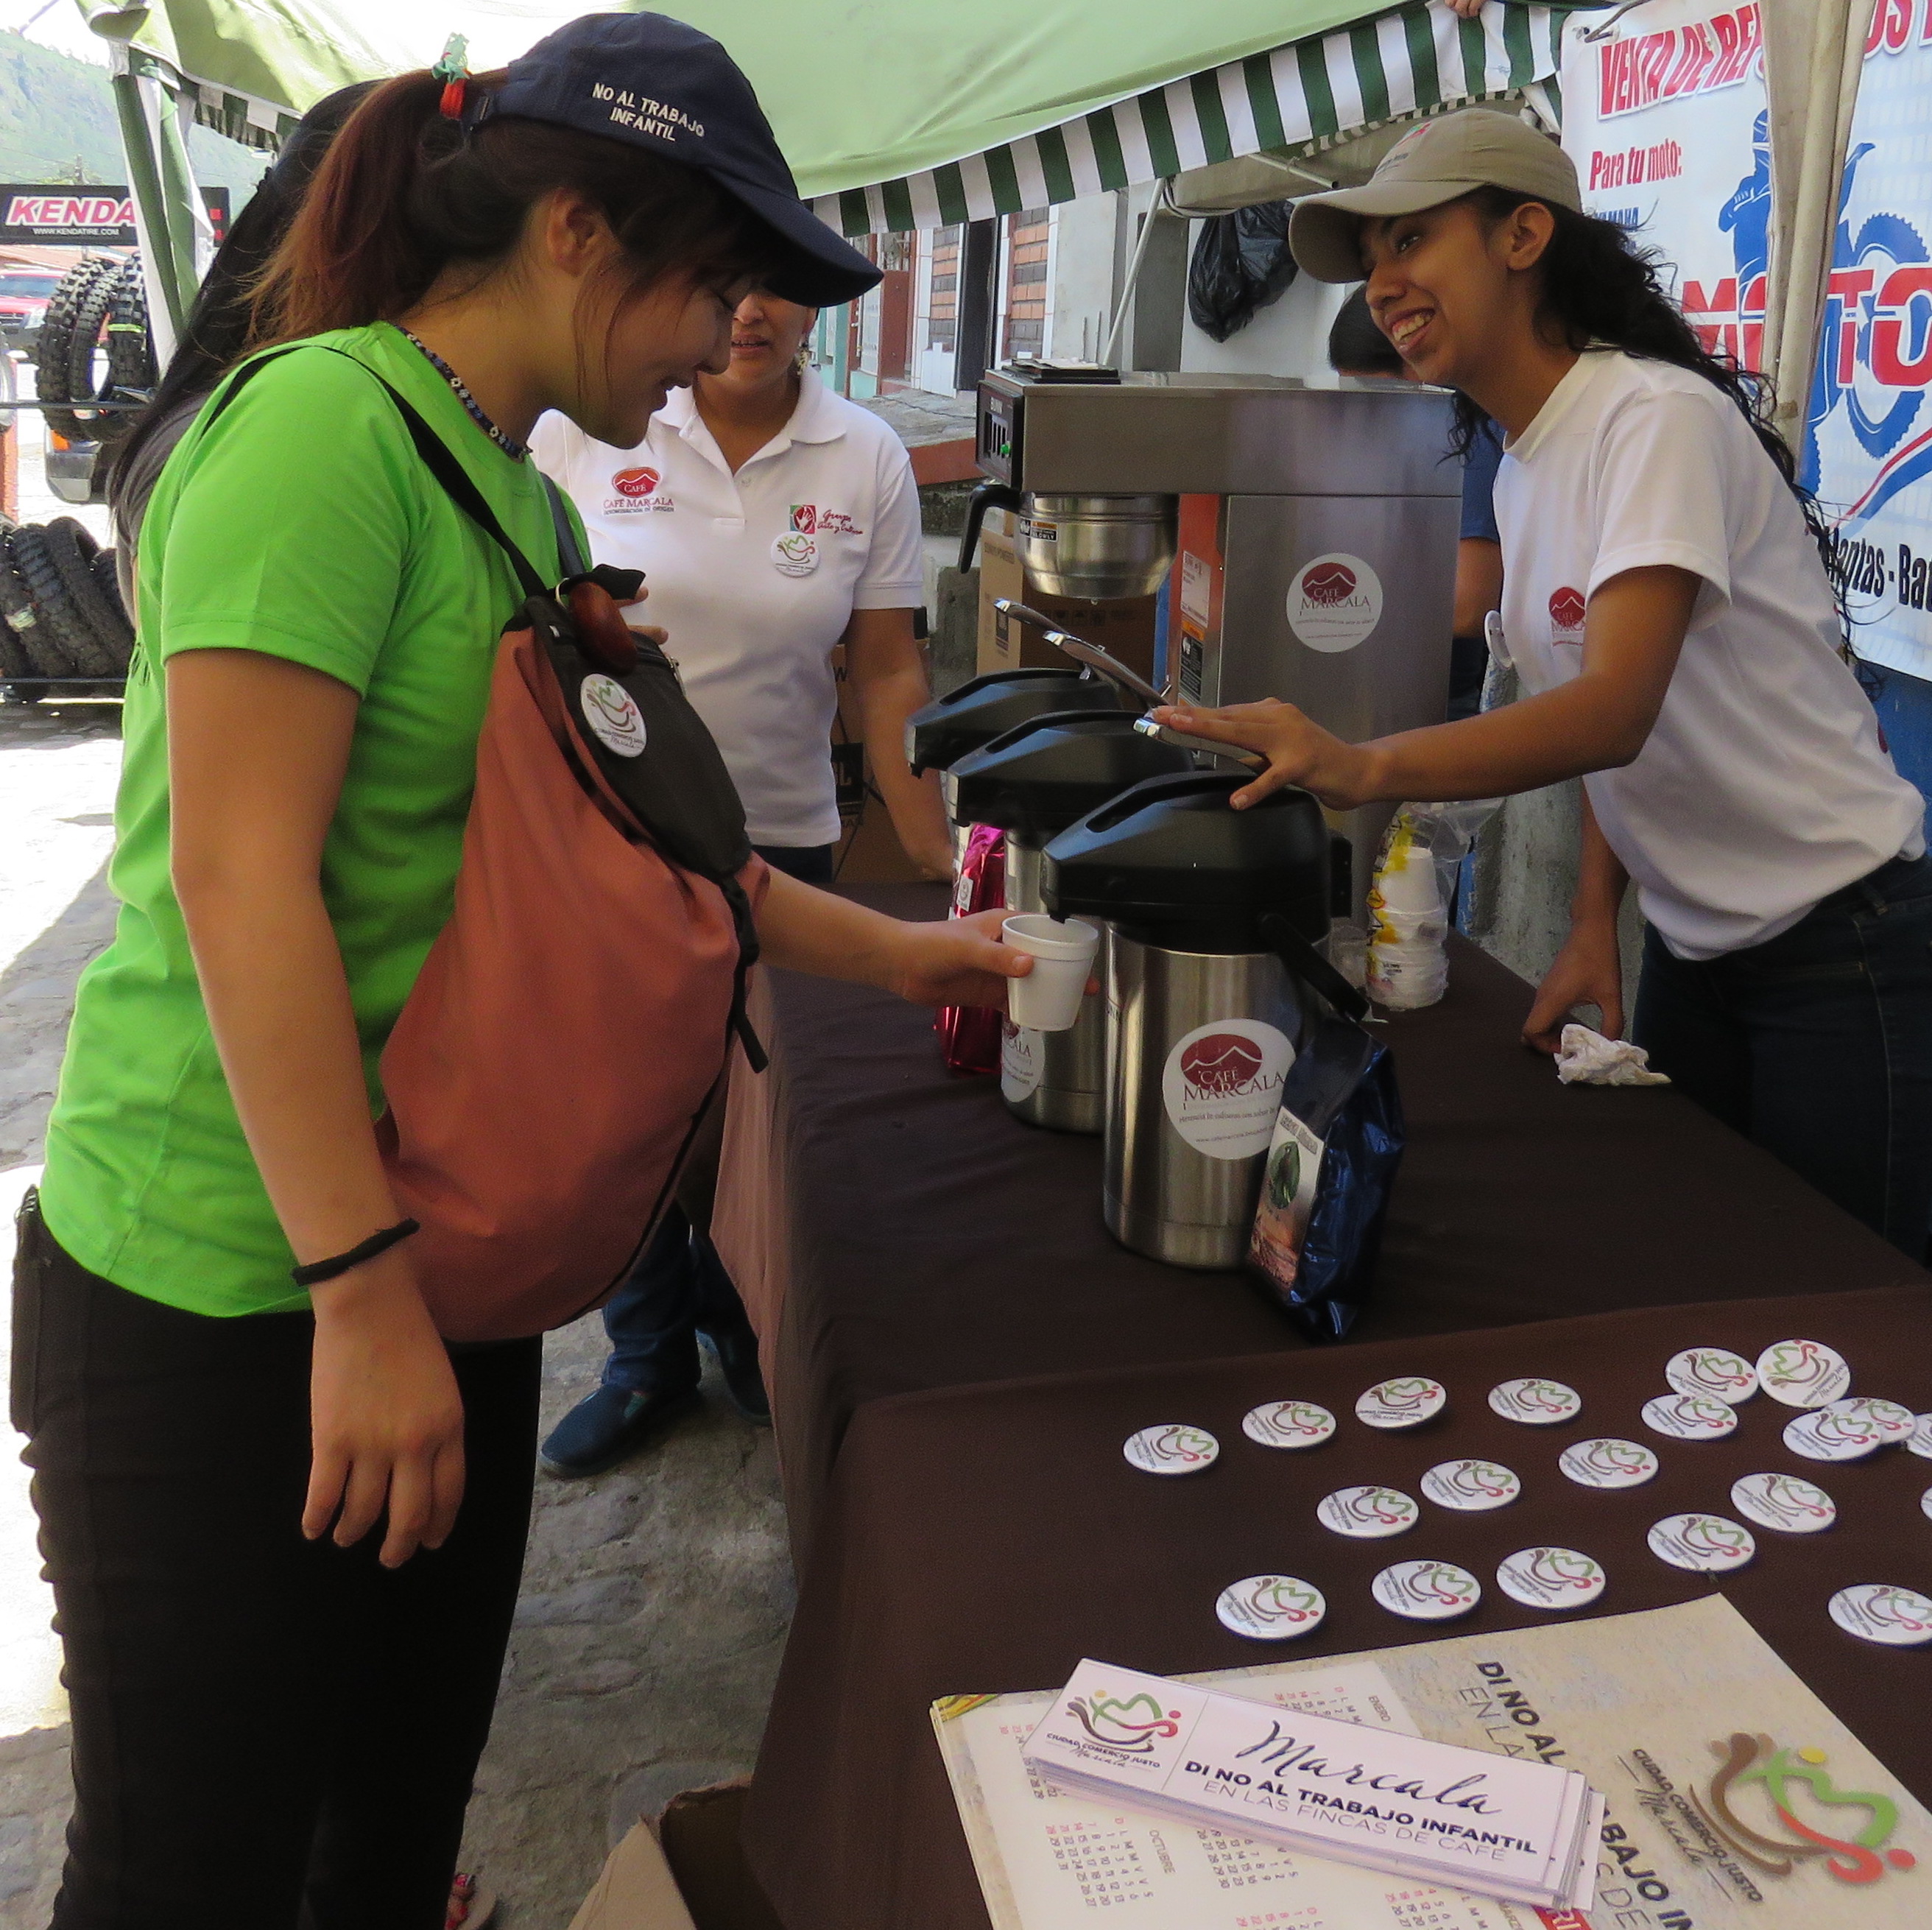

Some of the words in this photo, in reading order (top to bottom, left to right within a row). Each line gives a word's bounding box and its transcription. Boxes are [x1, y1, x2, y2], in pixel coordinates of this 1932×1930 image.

[1601, 30, 1676, 116] VENTA
[1662, 23, 1714, 96] DE
[592, 82, 614, 101] NO
[617, 90, 635, 108] AL
[641, 97, 705, 137] TRABAJO
[609, 107, 676, 141] INFANTIL
[1590, 150, 1623, 191] Para
[1628, 147, 1644, 184] tu
[1646, 138, 1682, 181] moto:
[7, 197, 136, 226] KENDA
[33, 228, 119, 236] WWW.KENDATIRE.COM
[627, 497, 674, 507] MARCALA
[1826, 527, 1884, 597] lantas
[1301, 595, 1370, 610] MARCALA
[1184, 1071, 1286, 1102] MARCALA
[1368, 1695, 1392, 1722] ENERO
[1459, 1688, 1501, 1718] EN
[1485, 1726, 1523, 1756] LA
[1476, 1662, 1512, 1685] DI
[1497, 1691, 1540, 1725] NO
[1525, 1733, 1566, 1764] AL
[1047, 1733, 1081, 1749] CIUDAD
[1082, 1744, 1129, 1760] COMERCIO
[1131, 1758, 1160, 1767] JUSTO
[1235, 1720, 1502, 1814] Marcala
[1185, 1761, 1210, 1775] DI
[1215, 1768, 1251, 1785] NO
[1257, 1781, 1288, 1796] AL
[1298, 1788, 1414, 1825] TRABAJO
[1421, 1818, 1537, 1854] INFANTIL
[1204, 1781, 1236, 1797] EN
[1244, 1790, 1290, 1811] LAS
[1297, 1804, 1387, 1834] FINCAS
[1395, 1827, 1431, 1844] DE
[1072, 1859, 1083, 1869] 24
[1149, 1830, 1176, 1873] OCTUBRE
